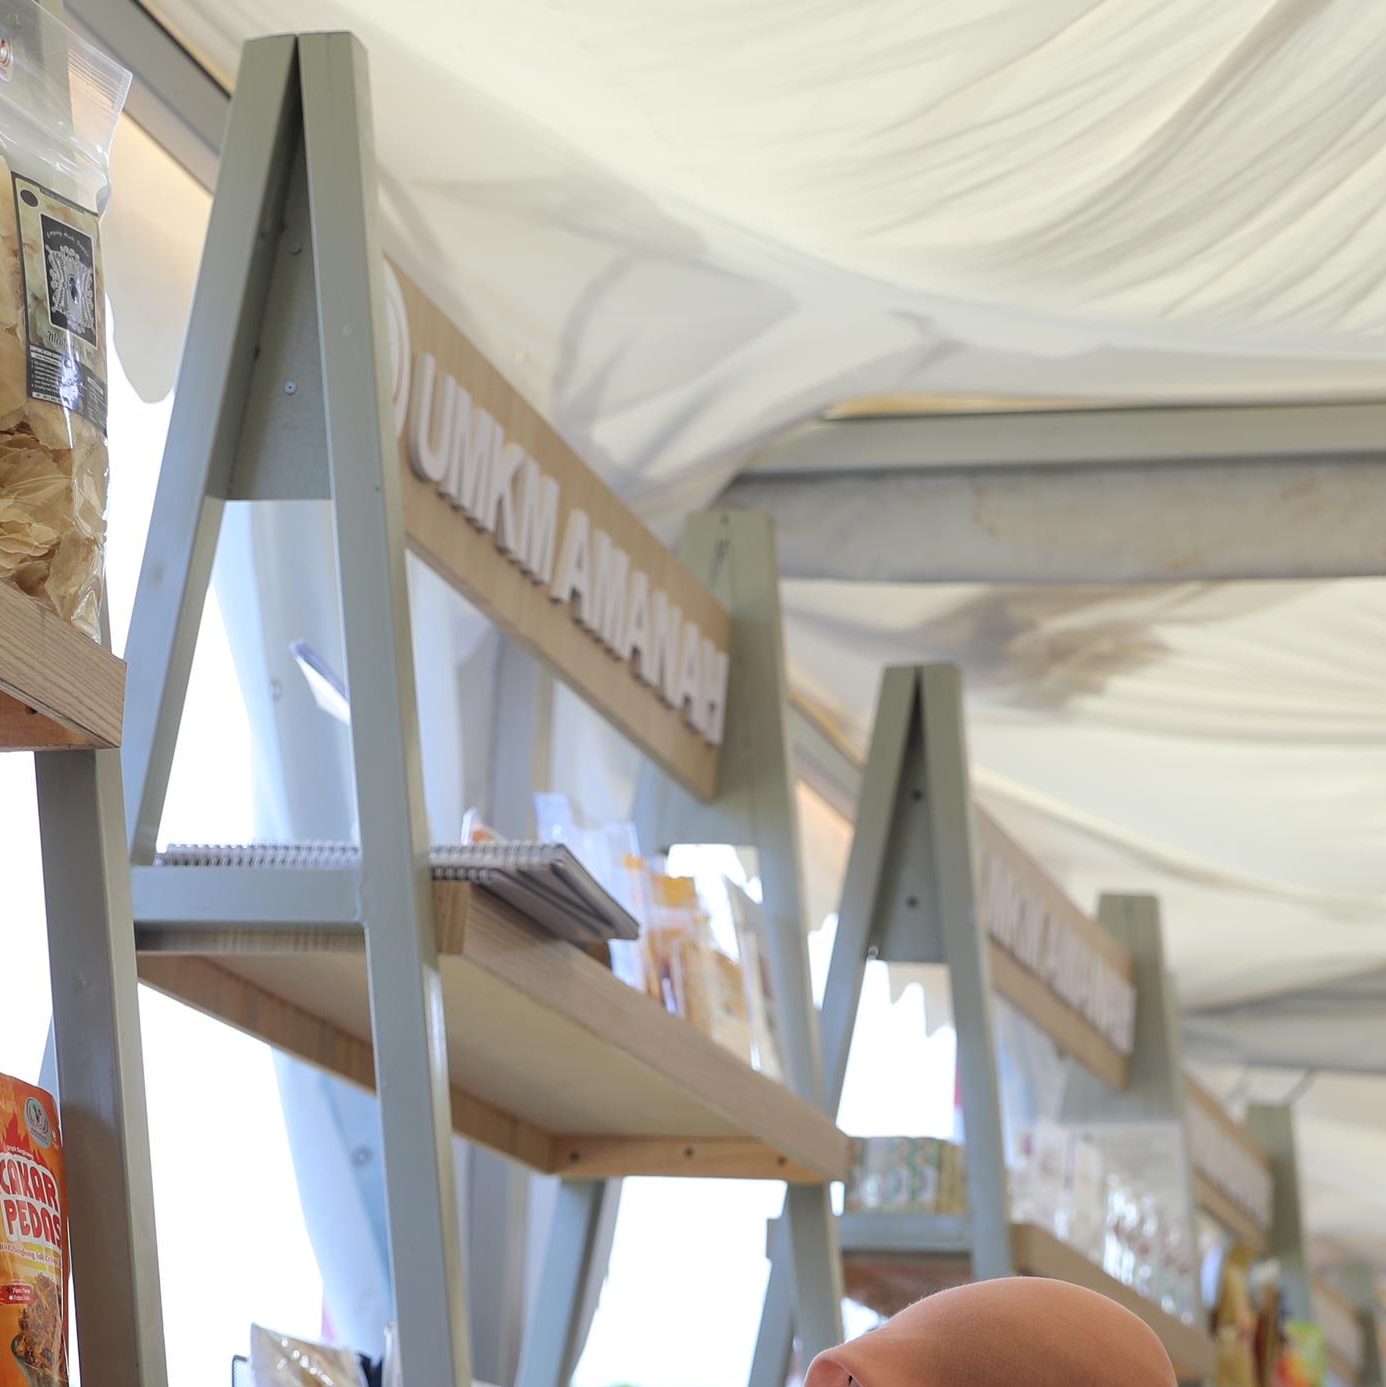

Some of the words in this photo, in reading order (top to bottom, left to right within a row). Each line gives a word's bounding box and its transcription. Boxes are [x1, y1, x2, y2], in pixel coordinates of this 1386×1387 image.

[412, 351, 560, 586] UMKM
[550, 509, 729, 746] AMANAH
[4, 1200, 62, 1250] PEDAS
